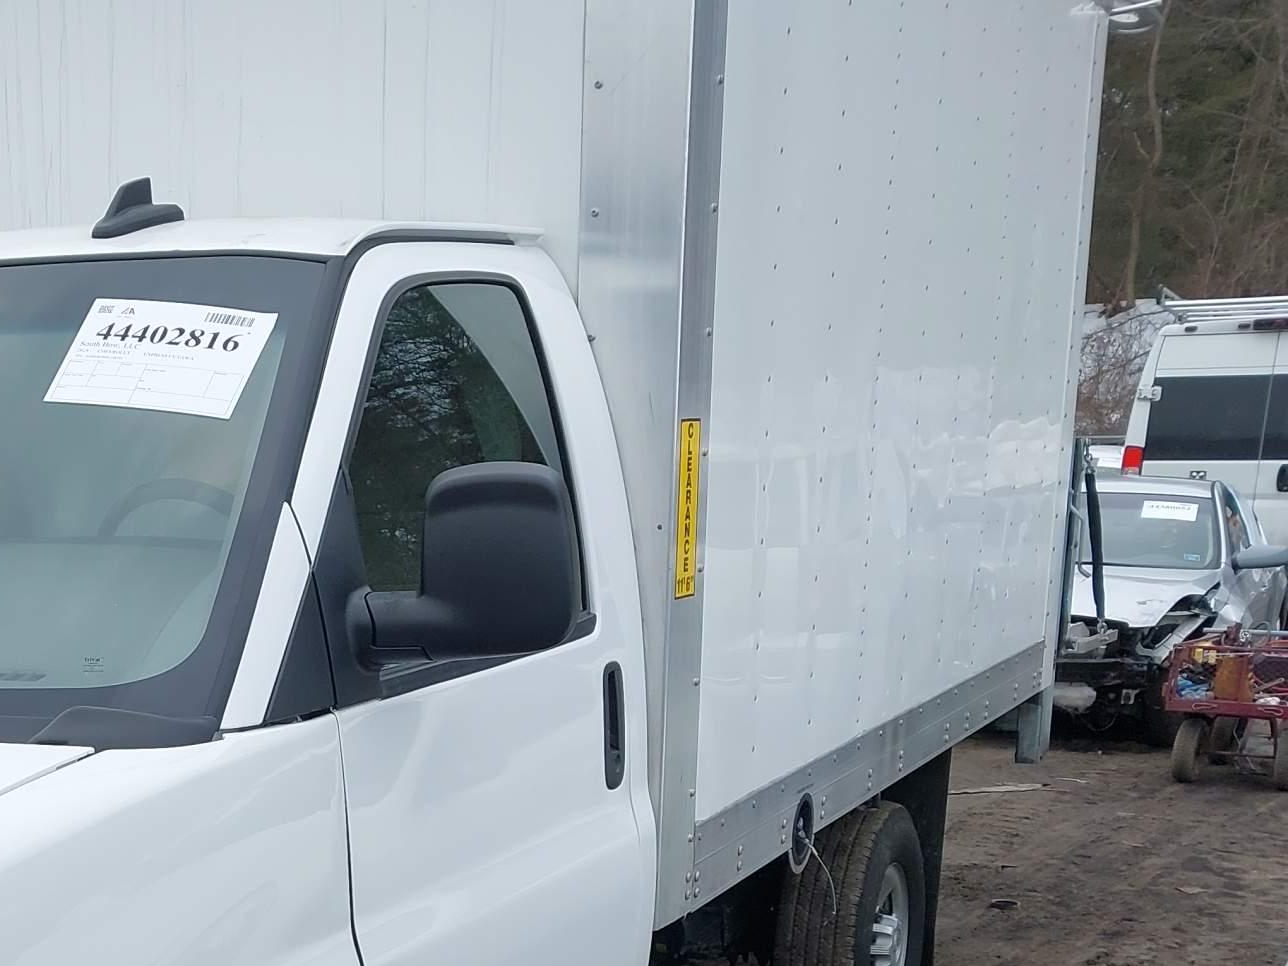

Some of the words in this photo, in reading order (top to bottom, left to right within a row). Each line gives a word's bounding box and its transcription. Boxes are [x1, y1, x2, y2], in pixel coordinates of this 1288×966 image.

[96, 322, 244, 353] 44402816
[123, 342, 142, 351] LLC
[683, 422, 694, 573] CLEARANCE
